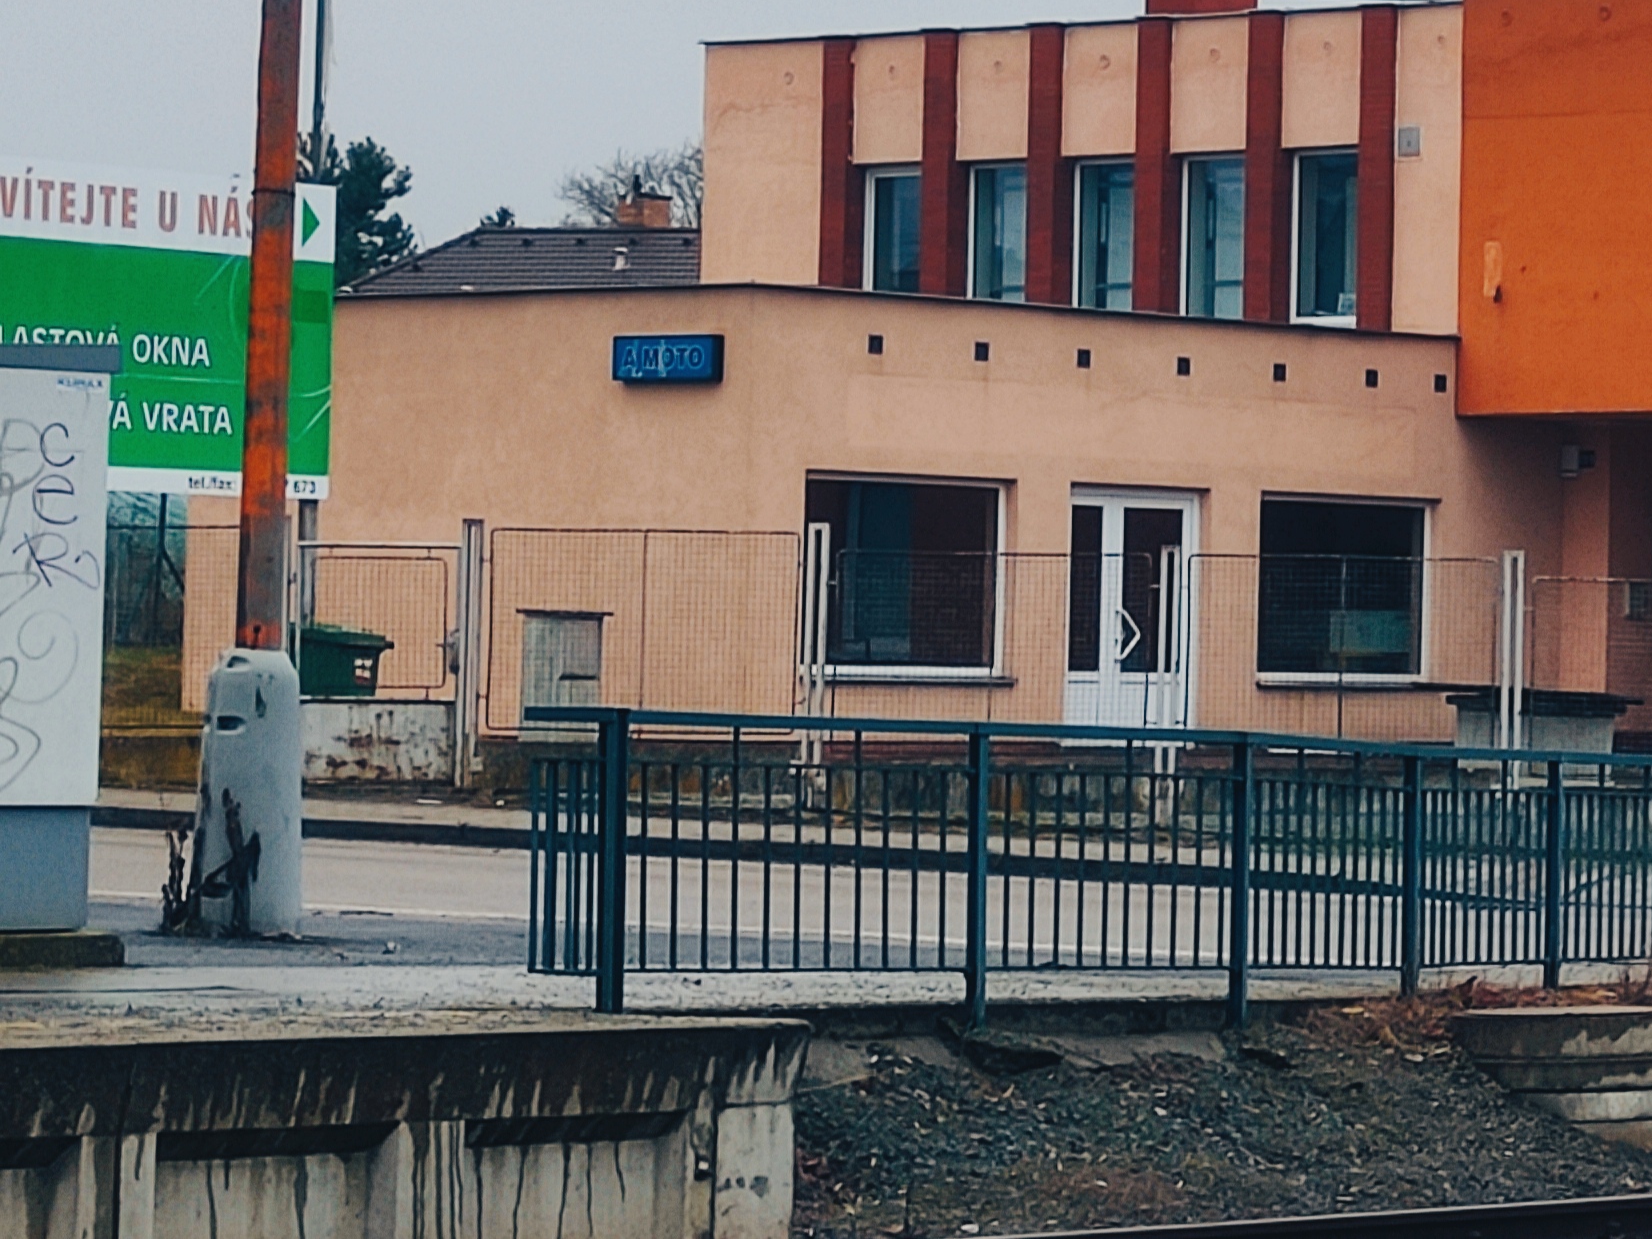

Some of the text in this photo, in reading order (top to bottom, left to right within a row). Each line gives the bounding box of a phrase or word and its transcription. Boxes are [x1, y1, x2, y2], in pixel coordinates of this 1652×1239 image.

[0, 167, 254, 239] VÍTEJTE U NÁ
[132, 333, 211, 368] OKNA
[142, 401, 233, 436] VRATA
